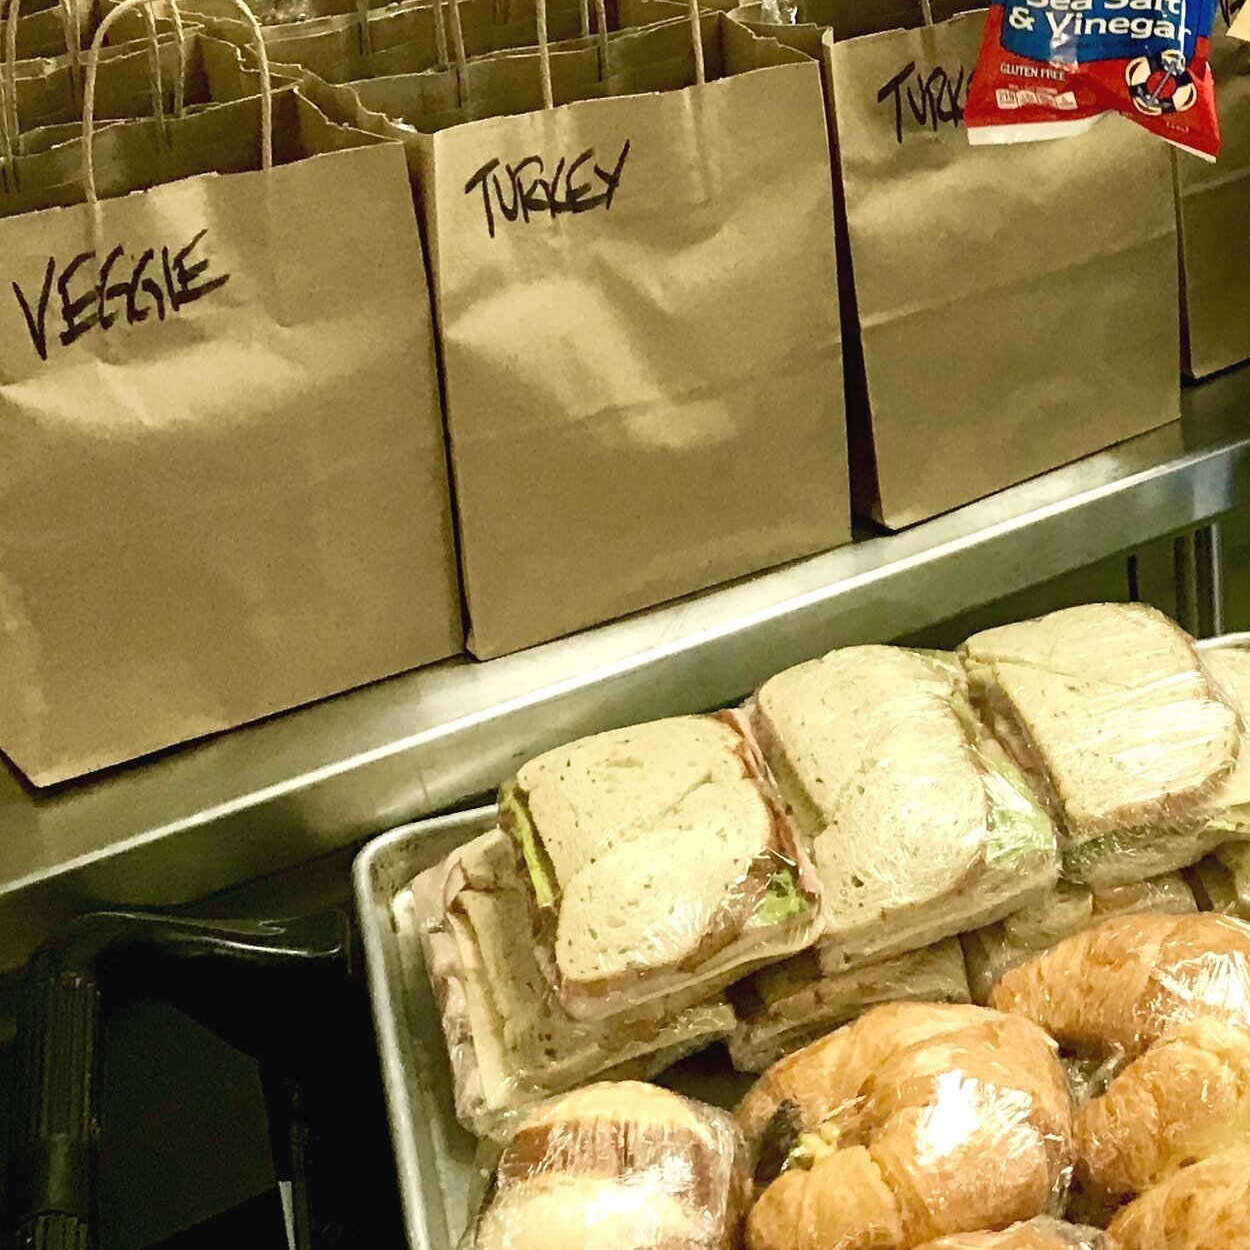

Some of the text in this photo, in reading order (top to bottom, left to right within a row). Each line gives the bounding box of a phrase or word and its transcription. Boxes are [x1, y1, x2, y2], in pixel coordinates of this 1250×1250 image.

[1009, 6, 1191, 41] & Vinegar
[1000, 62, 1066, 81] GLUTEN FREE
[465, 138, 630, 239] TURKEY
[12, 229, 230, 360] VEGGIE
